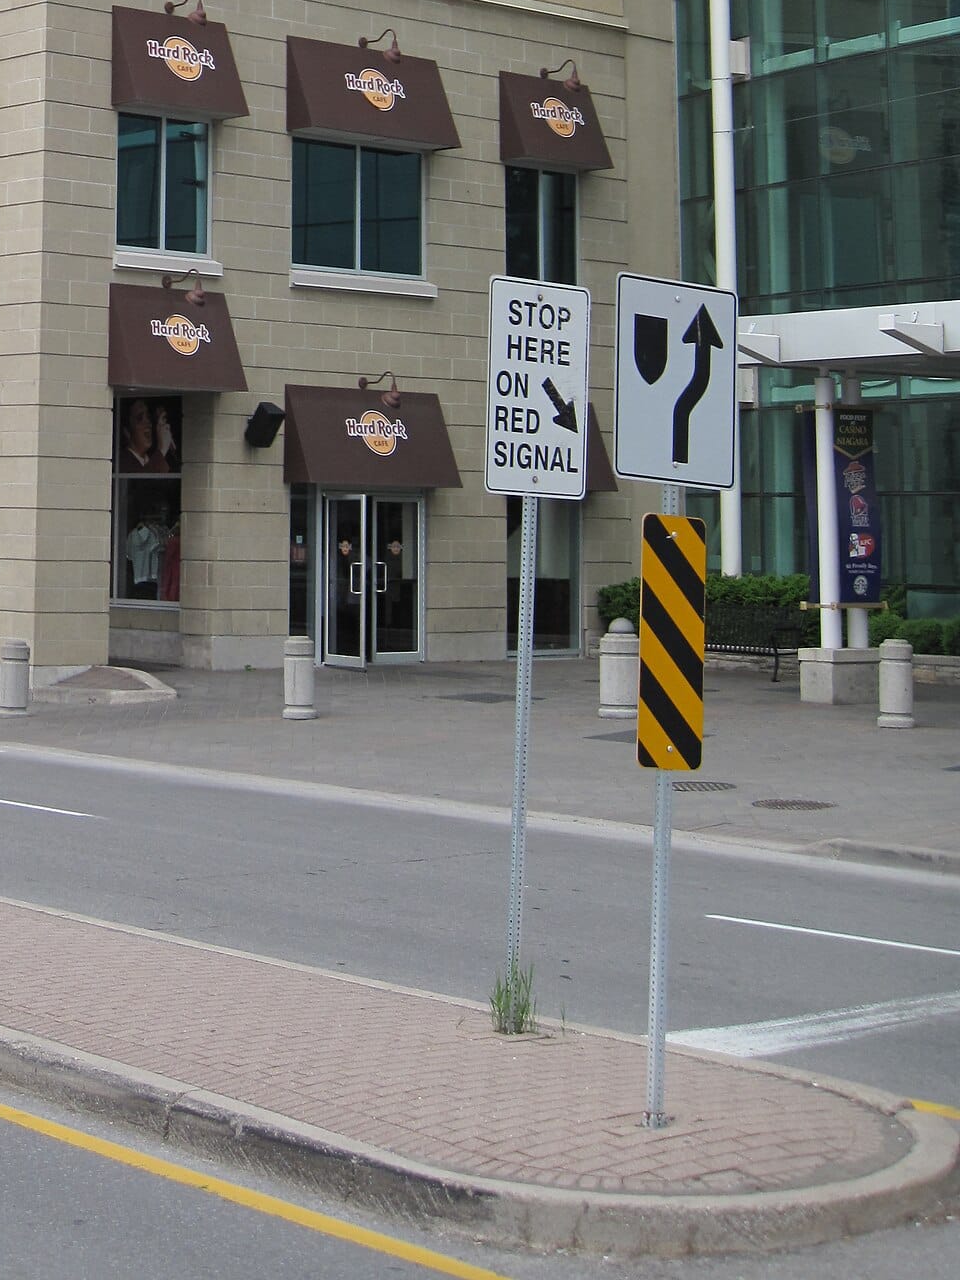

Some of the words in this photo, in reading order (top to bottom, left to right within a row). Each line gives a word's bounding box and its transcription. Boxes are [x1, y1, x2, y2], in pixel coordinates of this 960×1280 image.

[147, 40, 181, 59] Hard
[181, 46, 215, 69] Rock
[177, 65, 194, 73] CAFE
[345, 74, 374, 91] Hard
[375, 77, 406, 98] Rock
[531, 103, 557, 119] Hard
[556, 106, 584, 125] Rock
[509, 299, 571, 330] STOP
[151, 320, 181, 337] Hard
[180, 323, 210, 342] Rock
[507, 334, 570, 366] HERE
[496, 370, 529, 398] ON
[346, 419, 377, 436] Hard
[376, 419, 407, 439] Rock
[495, 406, 540, 434] RED
[839, 425, 867, 434] CASINO
[836, 436, 869, 446] NIAGARA
[494, 441, 578, 473] SIGNAL
